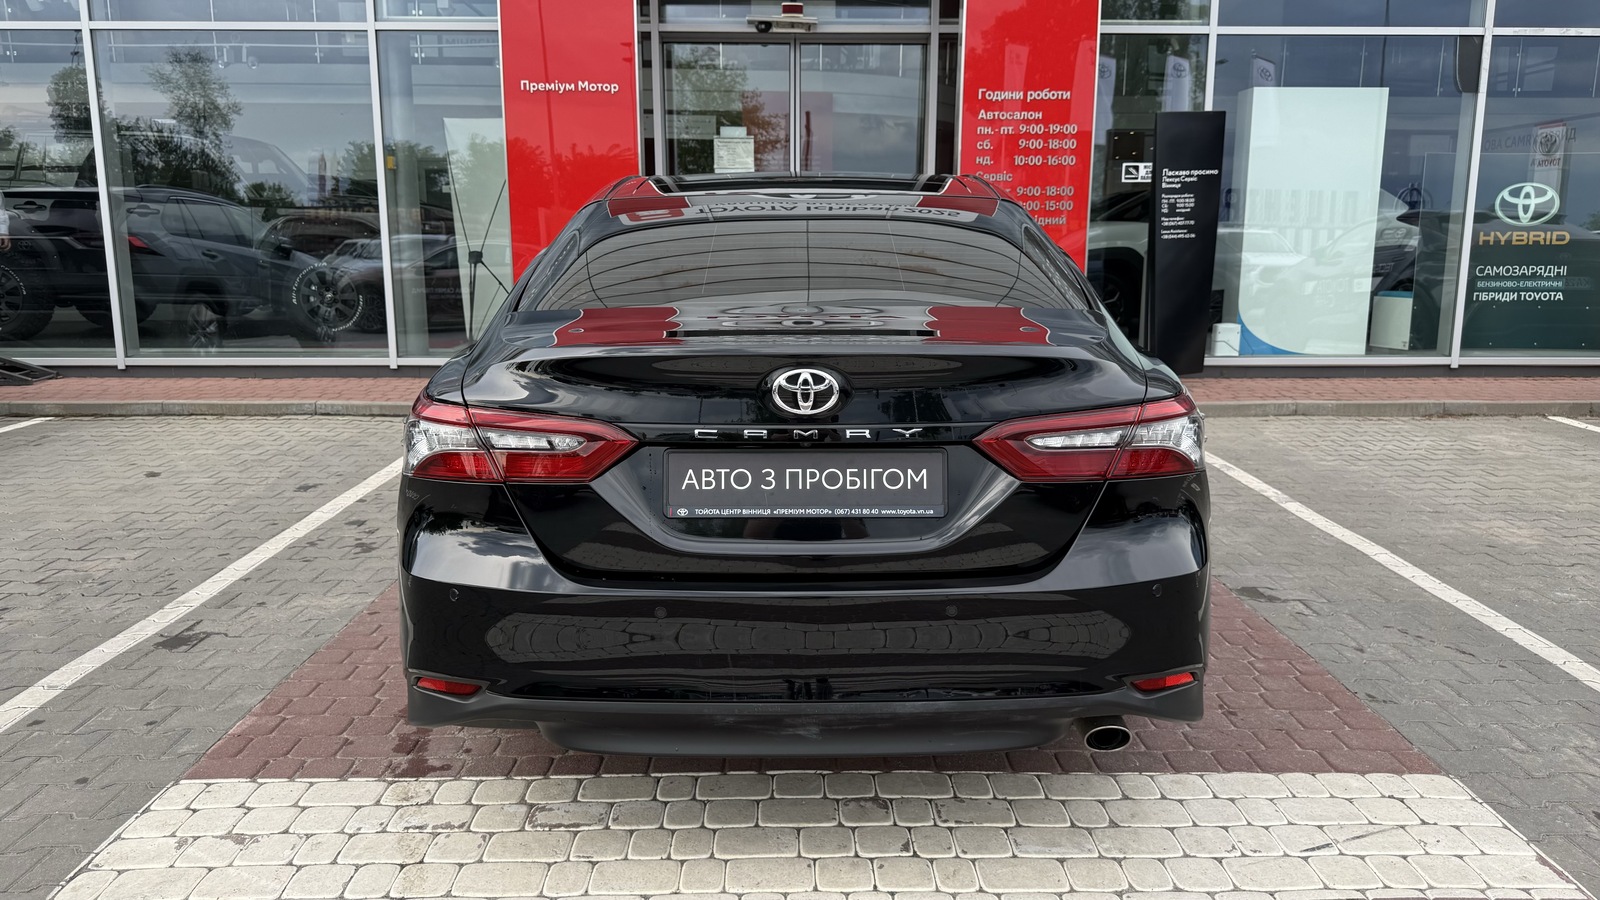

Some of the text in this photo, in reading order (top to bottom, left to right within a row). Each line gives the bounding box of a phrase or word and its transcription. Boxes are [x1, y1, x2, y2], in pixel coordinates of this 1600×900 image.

[520, 80, 619, 94] Преміум Мотор
[977, 88, 1071, 102] Години роботи
[977, 109, 1042, 120] Автосалон
[1019, 124, 1078, 135] 9:00-19:00
[976, 139, 1077, 150] сб. 9:00-18:00
[976, 155, 1076, 166] нд. 10:00-16:00
[1190, 169, 1219, 177] просимо
[1016, 186, 1074, 197] 9:00-18:00
[1020, 200, 1074, 211] :00-15:00
[1033, 214, 1067, 226] ідний
[1478, 231, 1571, 246] HYBRID
[1475, 265, 1567, 277] САМОЗАРЯДНІ
[1473, 291, 1564, 302] ГІБРИДИ TOYOTA
[694, 428, 924, 440] CAMRY
[682, 468, 928, 490] АВТО З ПРОБІГОМ
[695, 508, 934, 516] ТОЙОТА ЦЕНТР ВІННИЦЯ «ПРЕМІУМ МОТОР» (067) 431 80 40 www.toyota.vn.ua
